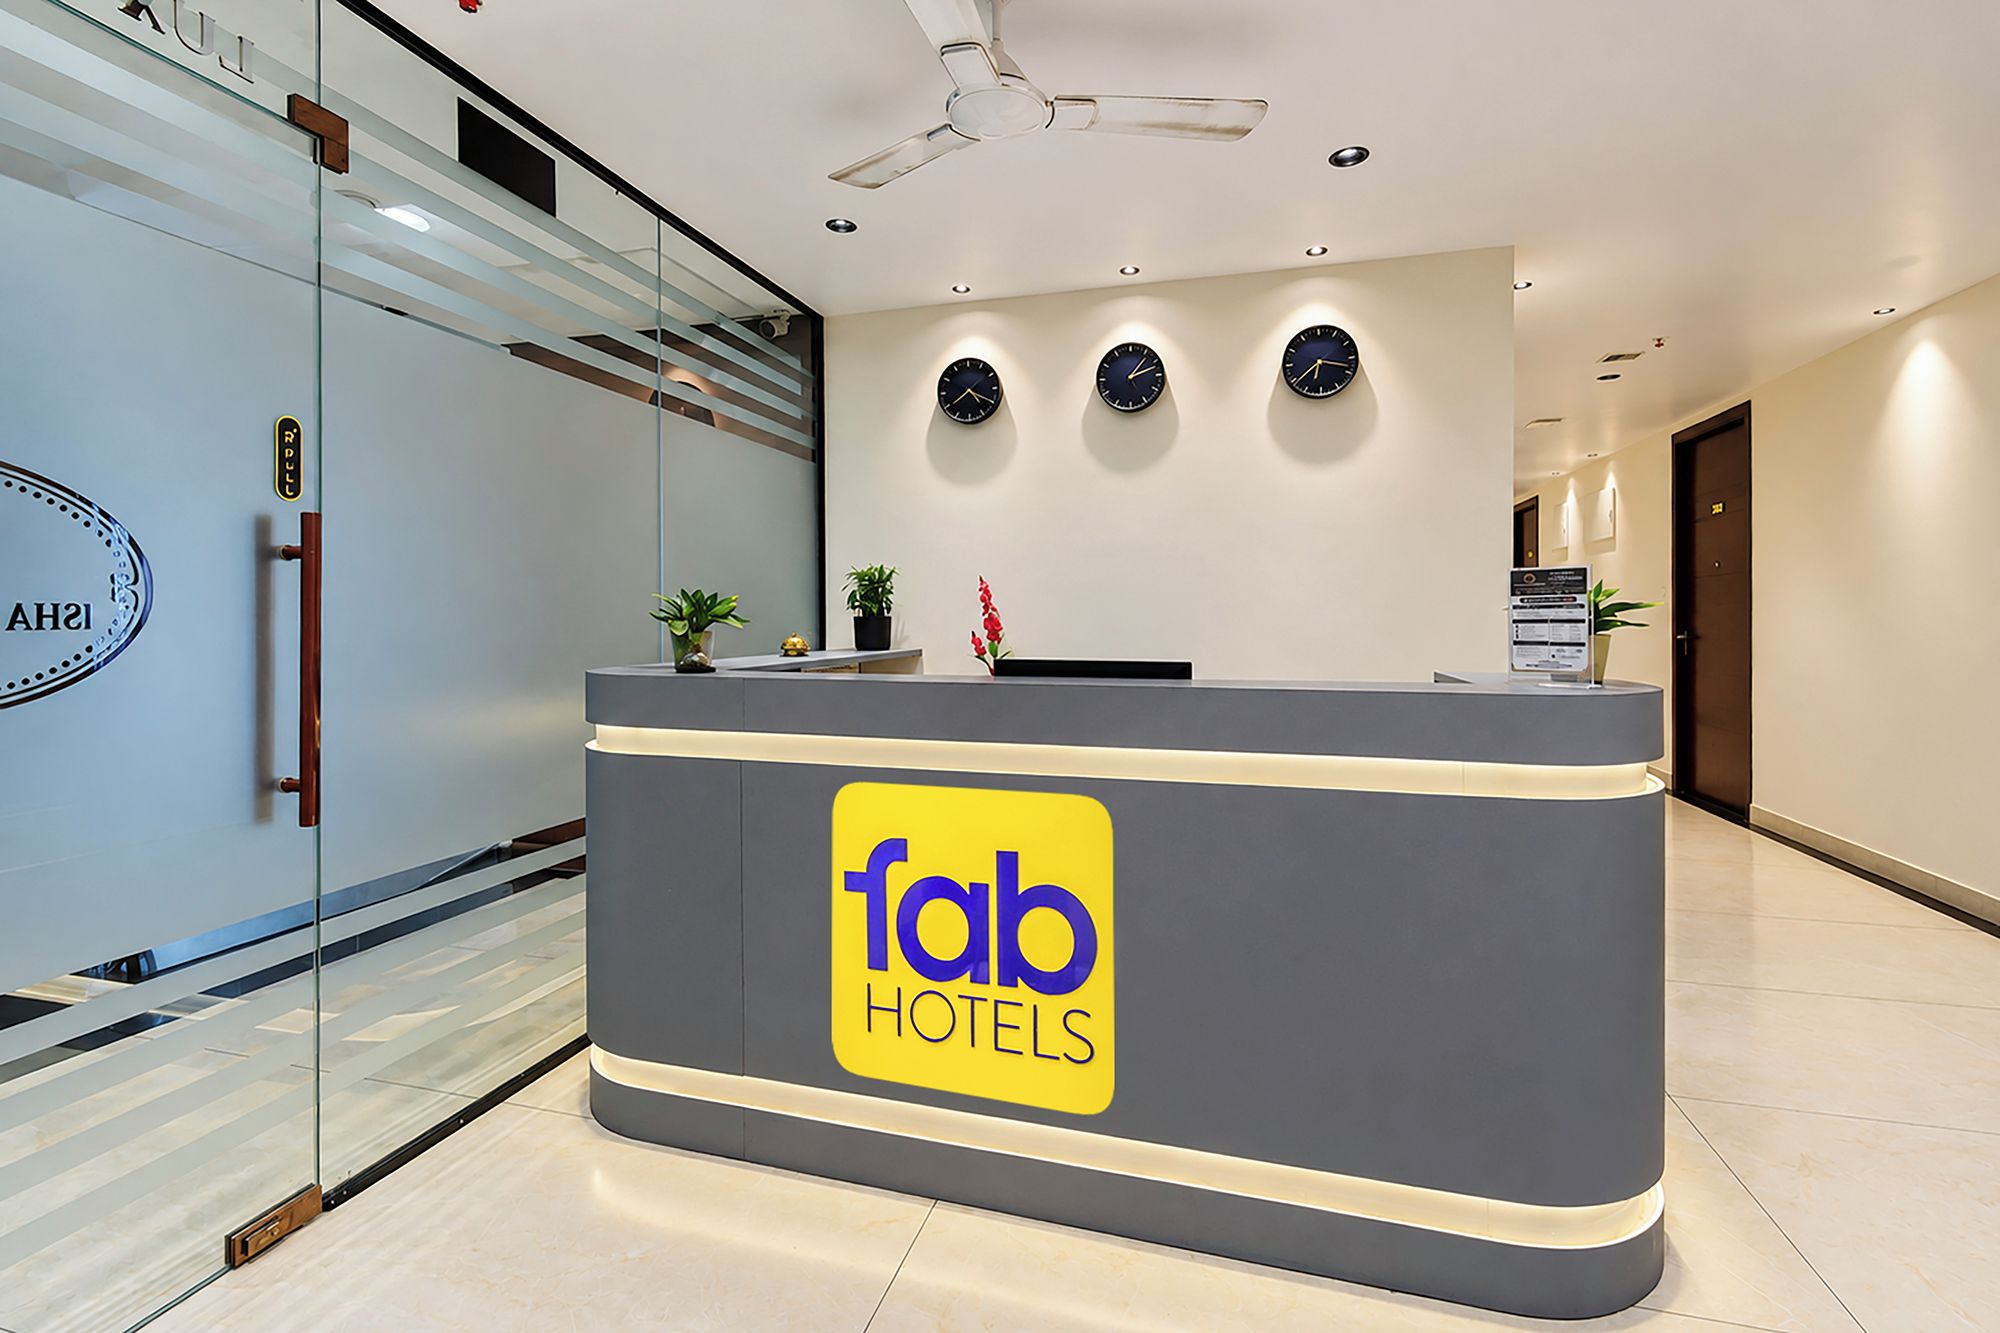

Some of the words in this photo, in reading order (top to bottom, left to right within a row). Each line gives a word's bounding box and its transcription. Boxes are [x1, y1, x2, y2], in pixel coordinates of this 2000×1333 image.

[284, 447, 295, 496] PULL
[844, 837, 1098, 996] fab
[867, 982, 1095, 1065] HOTELS
